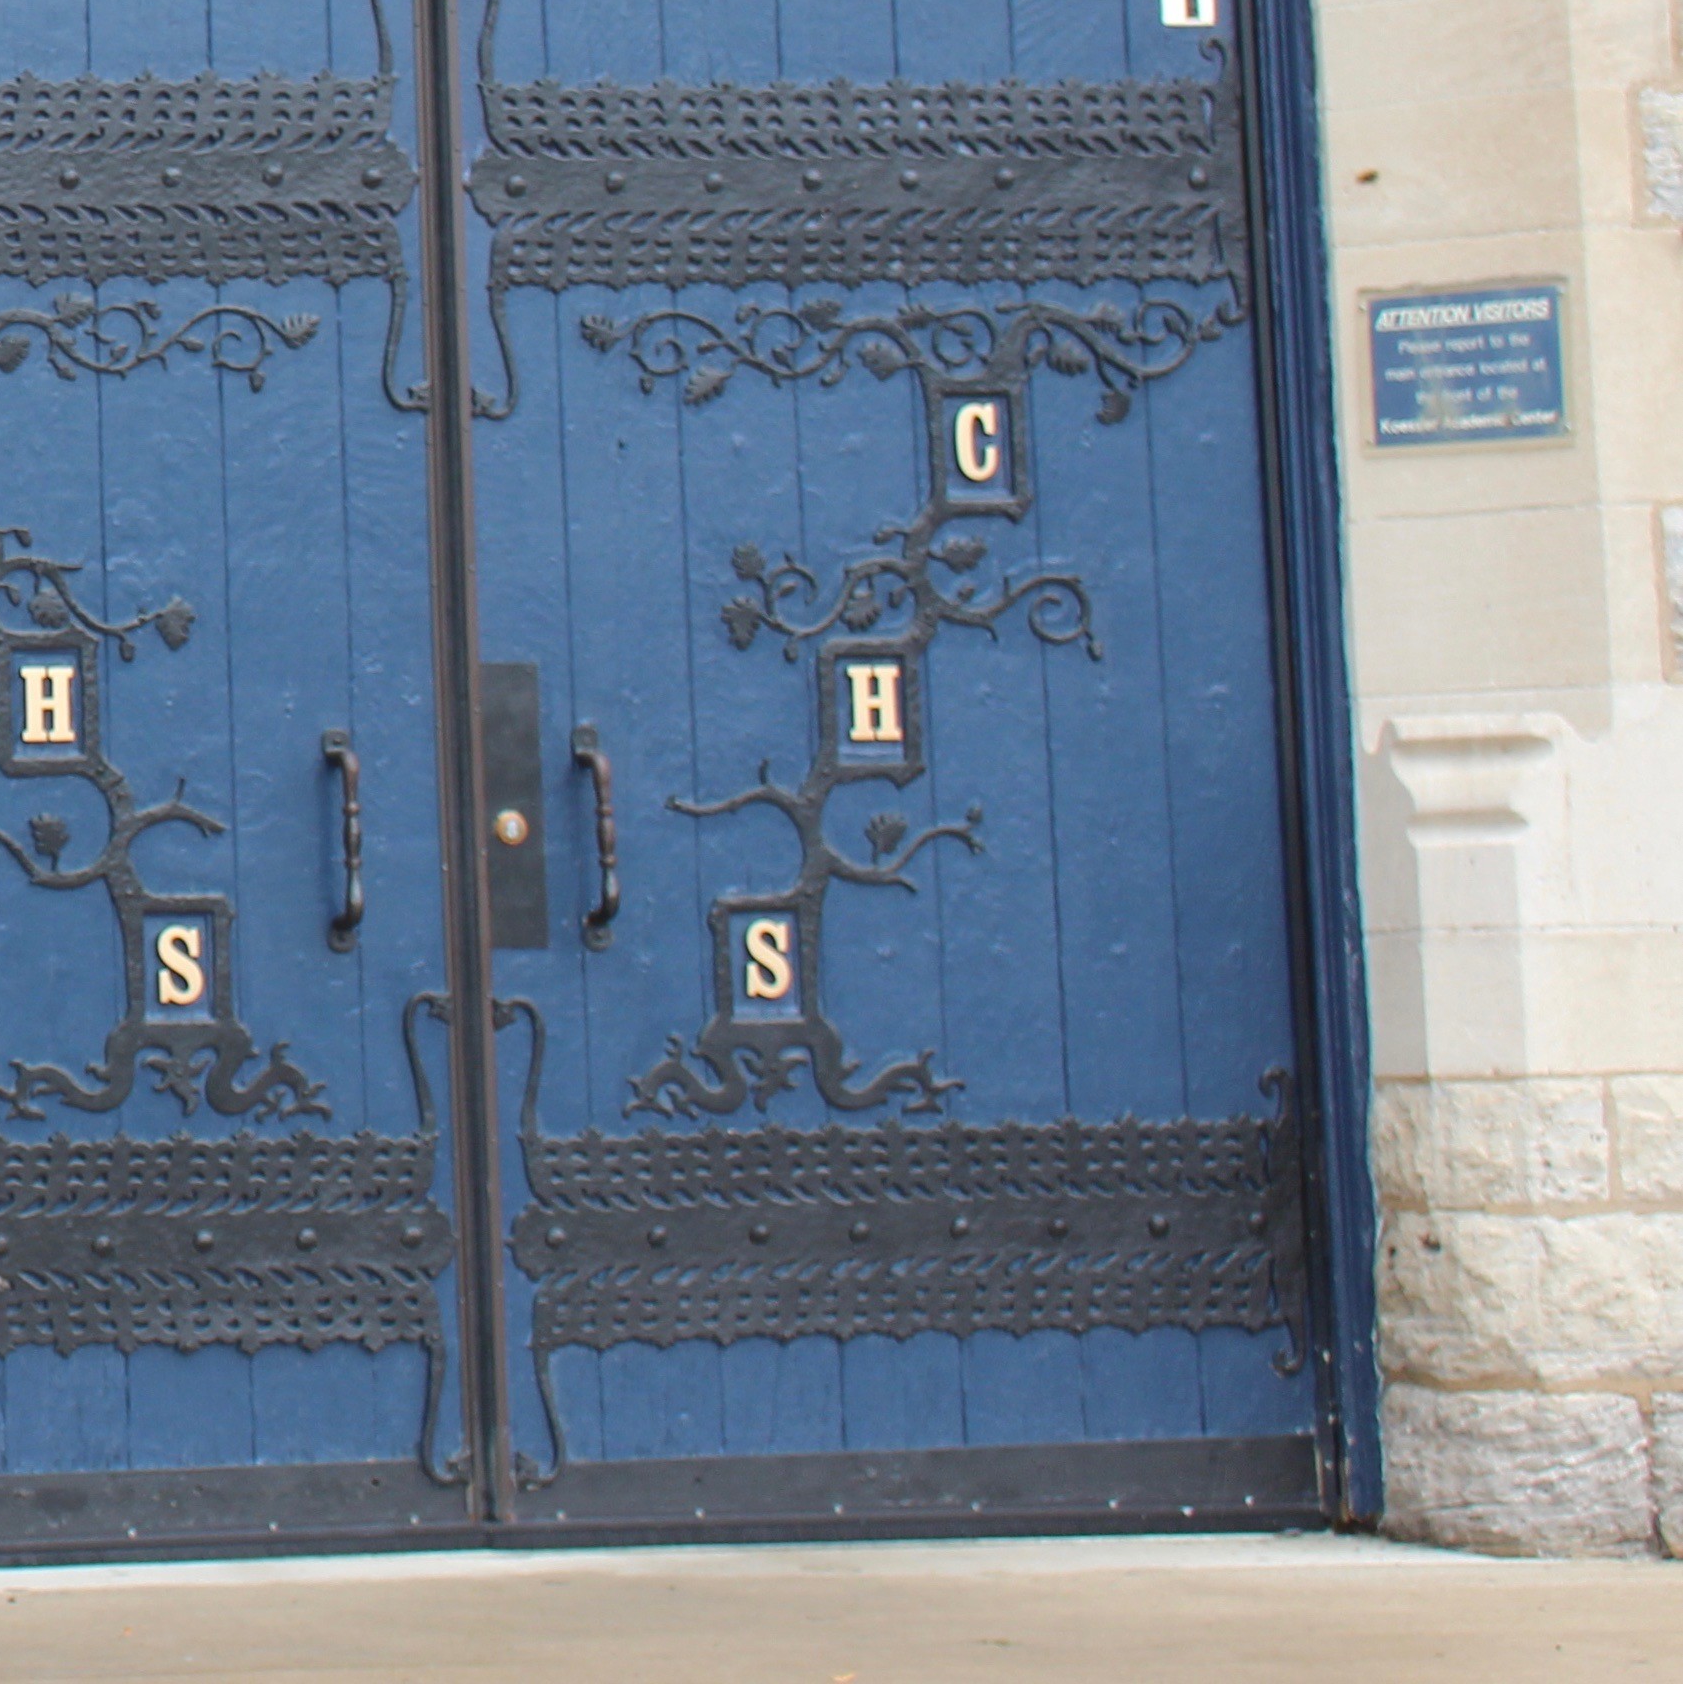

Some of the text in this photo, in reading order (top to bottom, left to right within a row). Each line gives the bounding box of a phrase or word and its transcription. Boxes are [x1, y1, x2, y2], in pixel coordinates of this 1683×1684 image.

[1375, 297, 1551, 332] ATTENTION VISITORS
[956, 404, 999, 481] C
[21, 667, 76, 742] H
[848, 665, 903, 741] H
[158, 927, 204, 1005] S
[747, 921, 791, 998] S
